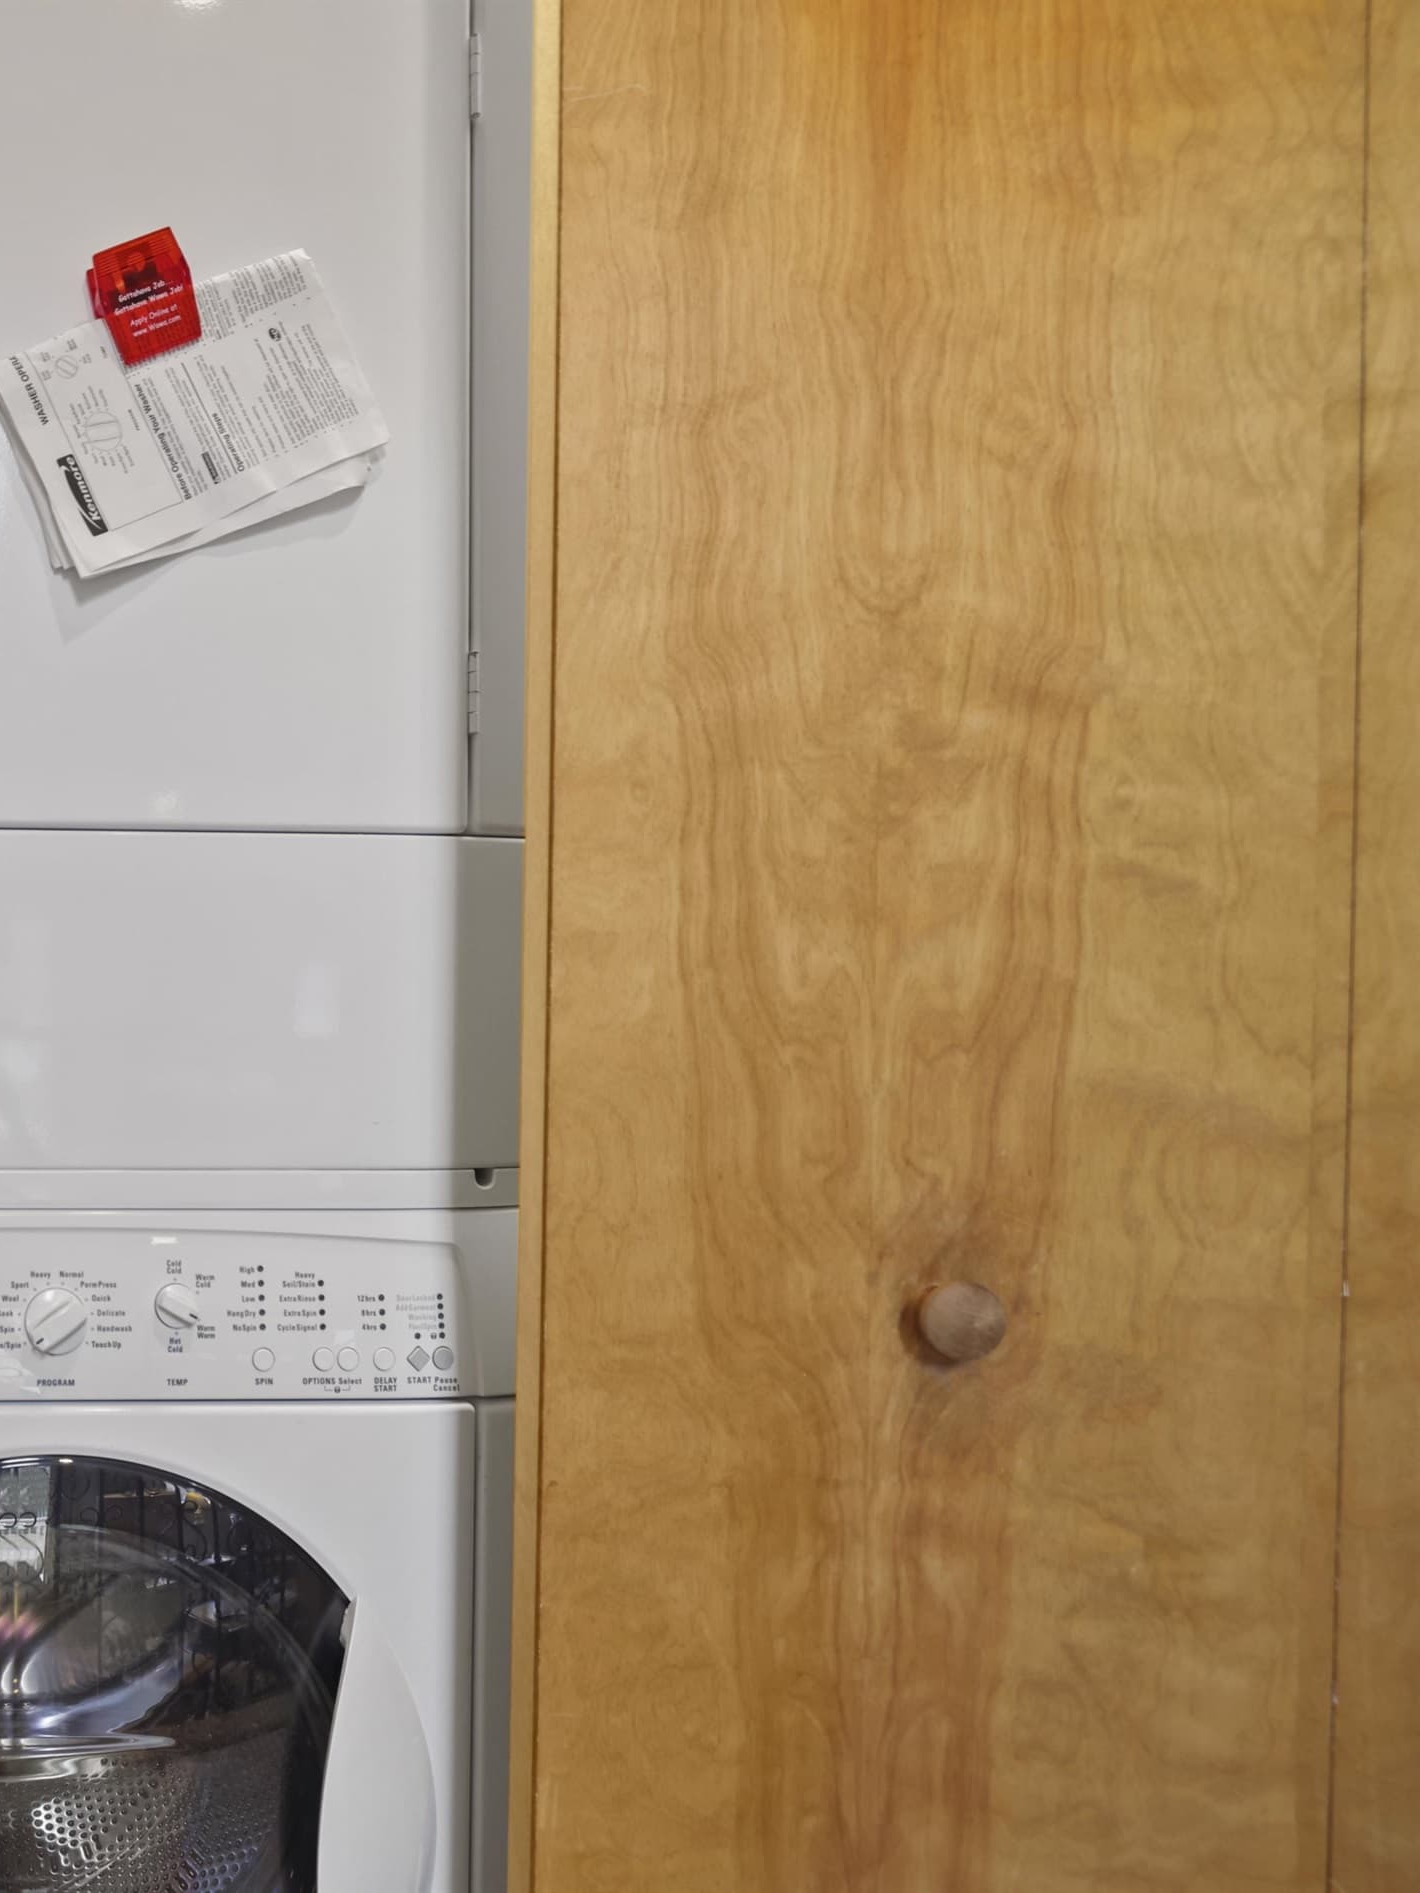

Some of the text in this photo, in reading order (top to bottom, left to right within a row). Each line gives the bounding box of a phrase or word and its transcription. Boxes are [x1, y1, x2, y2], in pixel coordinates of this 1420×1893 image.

[130, 304, 178, 327] Apply Online at
[25, 382, 50, 426] WASHER
[134, 384, 192, 500] Before Operating Your Washer
[212, 412, 245, 472] Operating Steps
[64, 455, 102, 522] Kenmore
[36, 1378, 75, 1387] PROGRAM
[166, 1378, 188, 1386] TEMP
[302, 1377, 362, 1385] OPTIONS Select
[374, 1376, 397, 1384] DELAY
[407, 1376, 458, 1384] START Pause
[433, 1384, 460, 1392] Cancel
